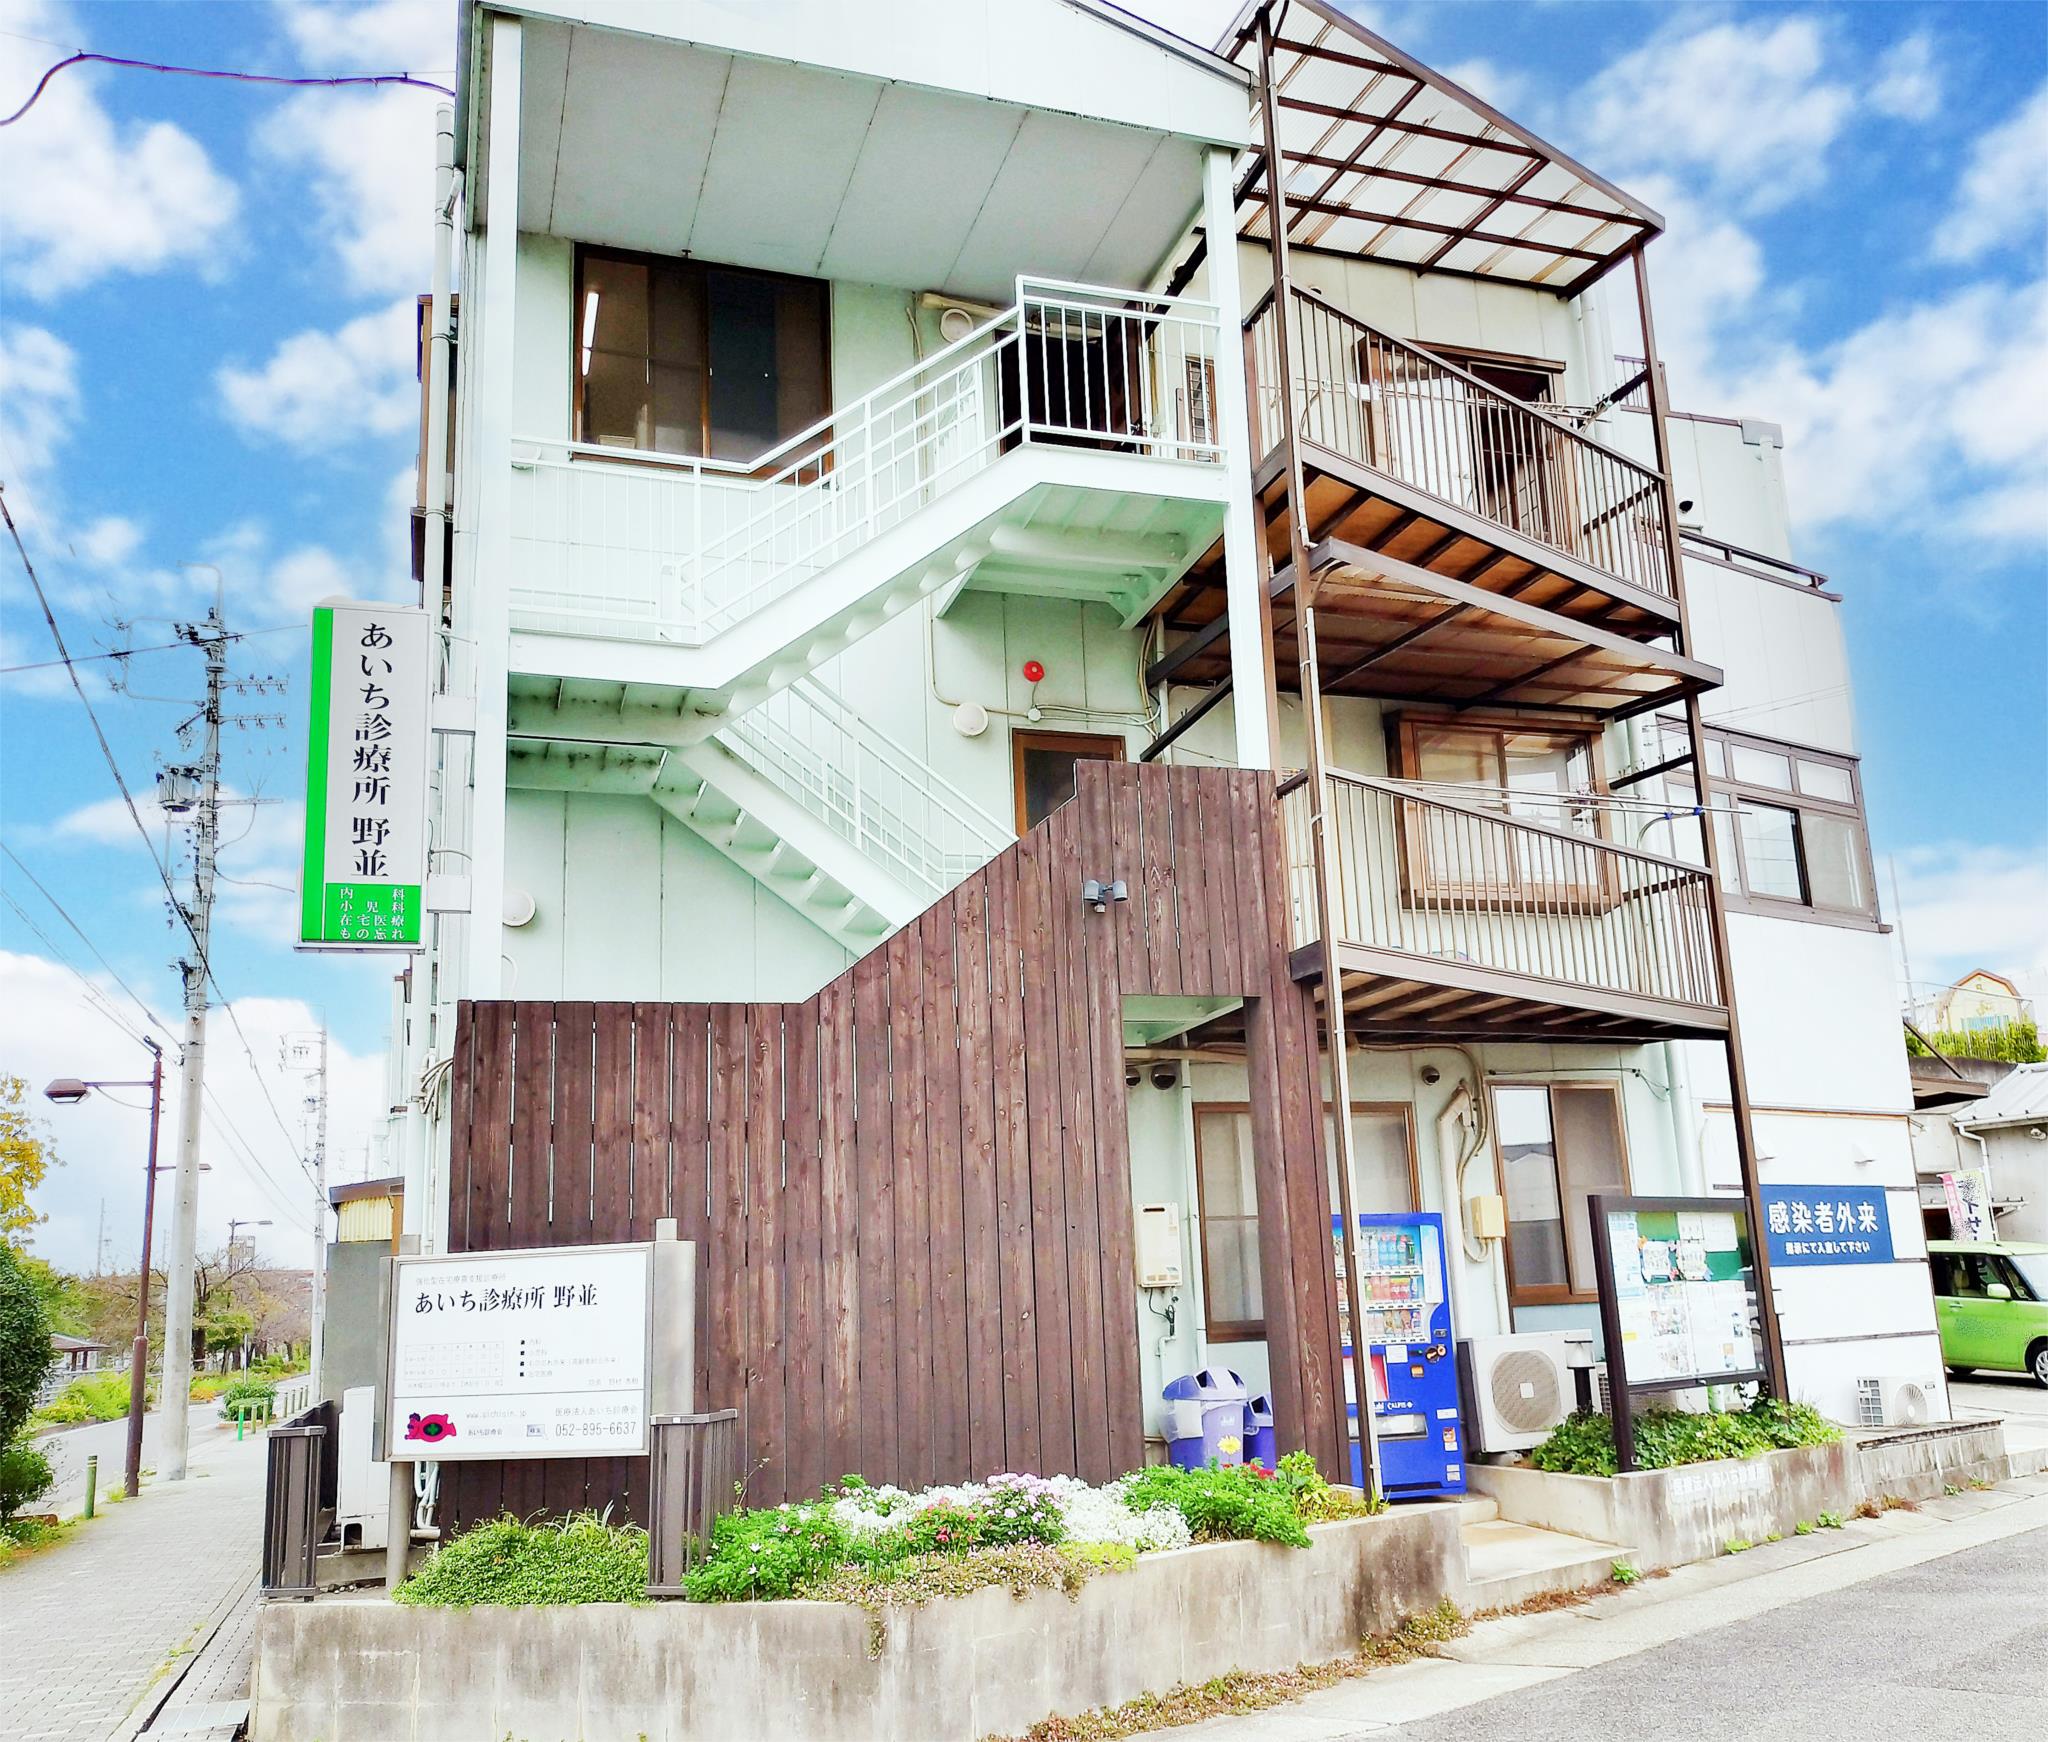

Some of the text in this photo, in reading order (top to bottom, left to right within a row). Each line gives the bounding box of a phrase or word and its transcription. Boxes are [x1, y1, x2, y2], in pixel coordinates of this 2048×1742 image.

[351, 622, 393, 877] あいち診療所 野並
[340, 887, 405, 901] 内科
[340, 900, 405, 914] 小児科
[340, 914, 405, 928] 在宅医療
[340, 928, 405, 940] もの忘れ
[1768, 1200, 1880, 1234] 感染者外来
[415, 1283, 599, 1314] あいち診療所 野並
[555, 1421, 637, 1437] 052-895-6637
